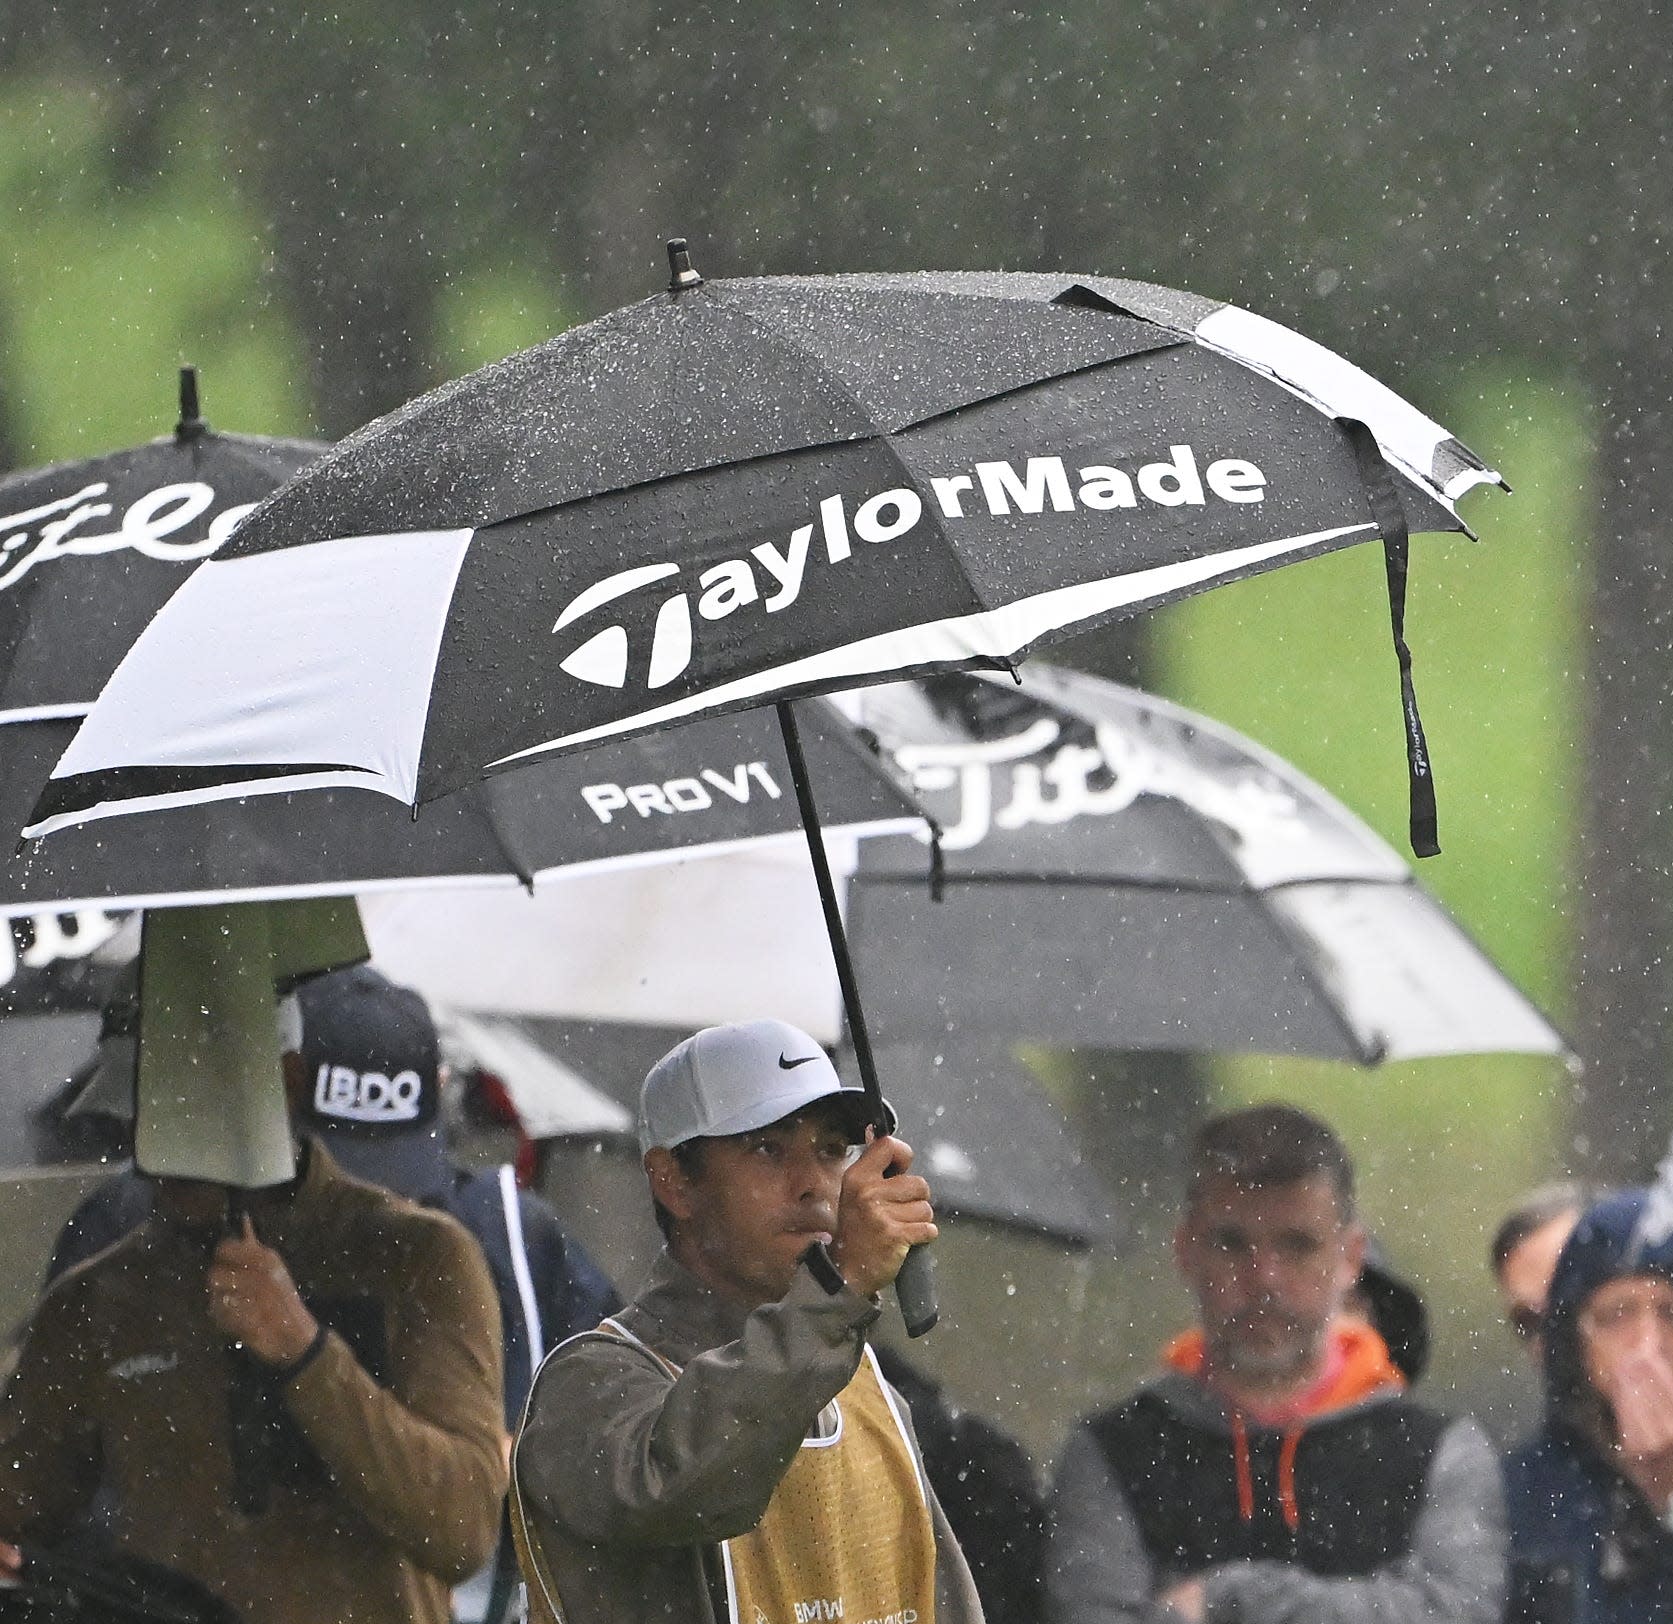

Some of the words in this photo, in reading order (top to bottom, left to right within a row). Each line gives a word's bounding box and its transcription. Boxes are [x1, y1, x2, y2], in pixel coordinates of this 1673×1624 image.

[552, 444, 1268, 689] TaylorMade
[581, 782, 713, 825] PRO
[700, 760, 782, 805] V1
[793, 1596, 844, 1624] BMW
